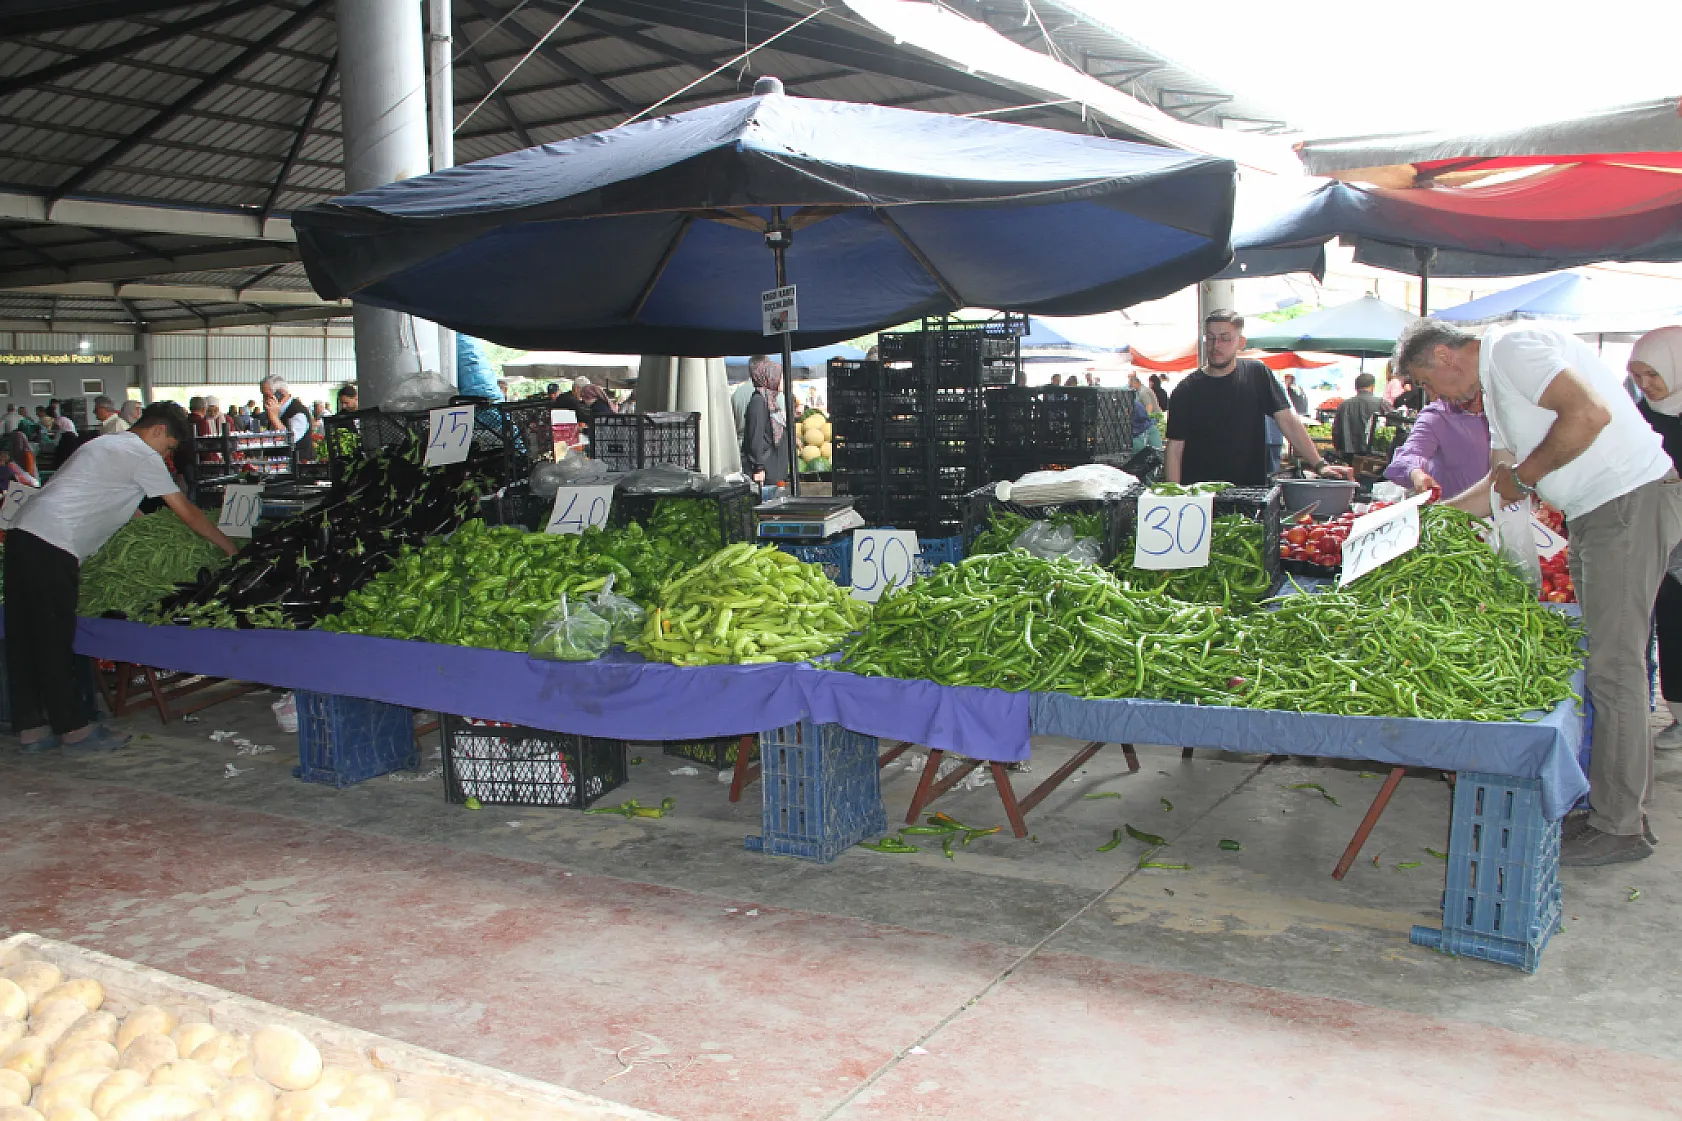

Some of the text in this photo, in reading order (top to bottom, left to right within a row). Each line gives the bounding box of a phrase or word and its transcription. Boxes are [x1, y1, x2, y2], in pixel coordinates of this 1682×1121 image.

[71, 354, 95, 364] Pazar
[552, 493, 606, 531] 40
[1138, 503, 1207, 555] 30
[852, 536, 911, 591] 30
